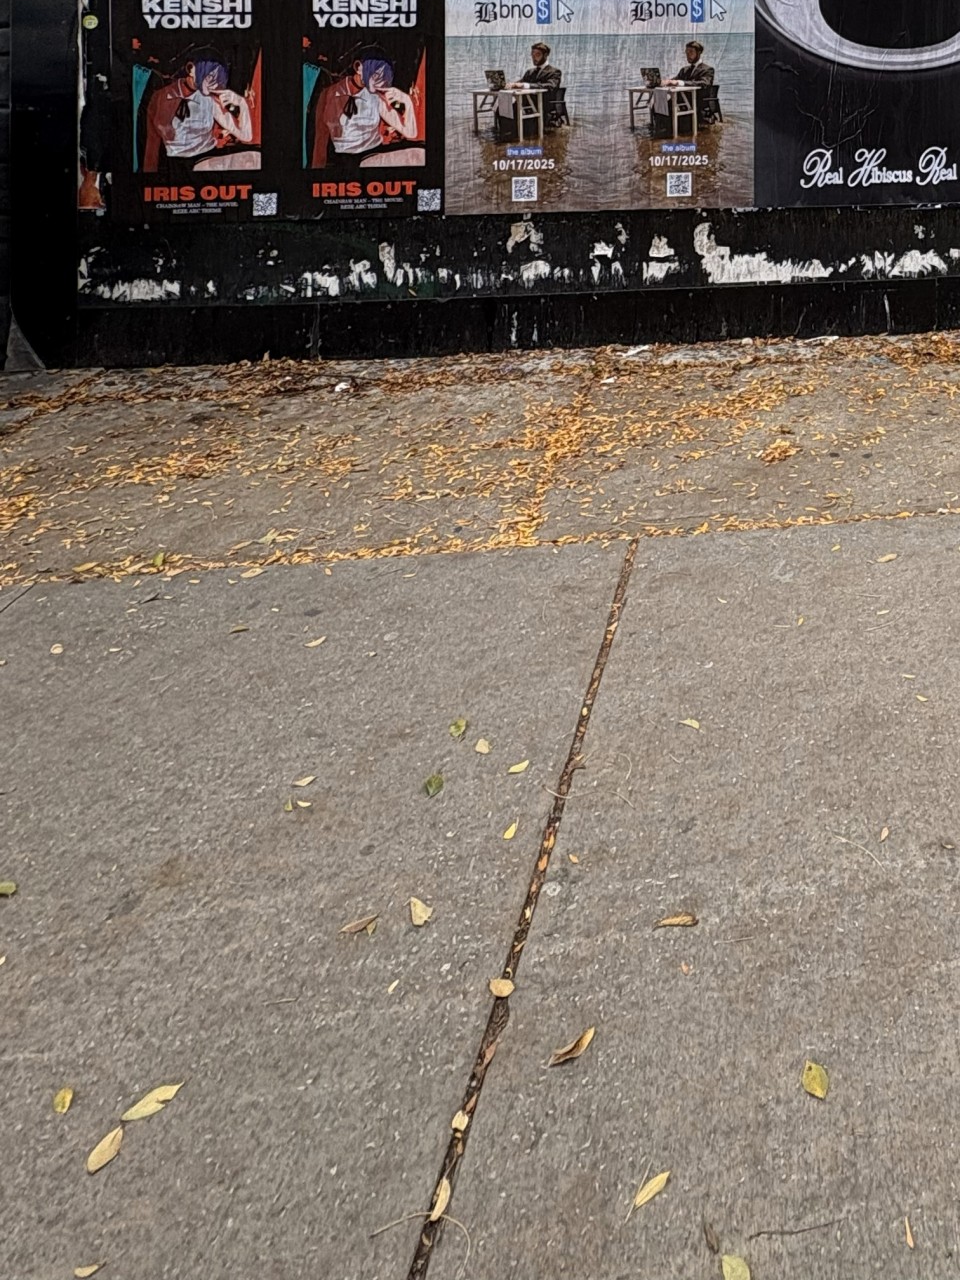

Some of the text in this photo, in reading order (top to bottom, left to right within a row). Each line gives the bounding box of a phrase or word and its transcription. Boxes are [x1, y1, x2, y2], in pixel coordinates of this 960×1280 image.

[143, 13, 252, 29] YONEZU
[313, 13, 417, 28] YONEZU
[506, 147, 543, 156] the album
[661, 143, 696, 152] the album
[492, 159, 555, 170] 10/17/2025
[649, 155, 709, 167] 10/17/2025
[800, 147, 844, 188] Real
[847, 147, 913, 187] Hibiscus
[916, 146, 958, 186] Real
[144, 184, 252, 202] IRIS OUT
[312, 180, 417, 198] IRIS OUT
